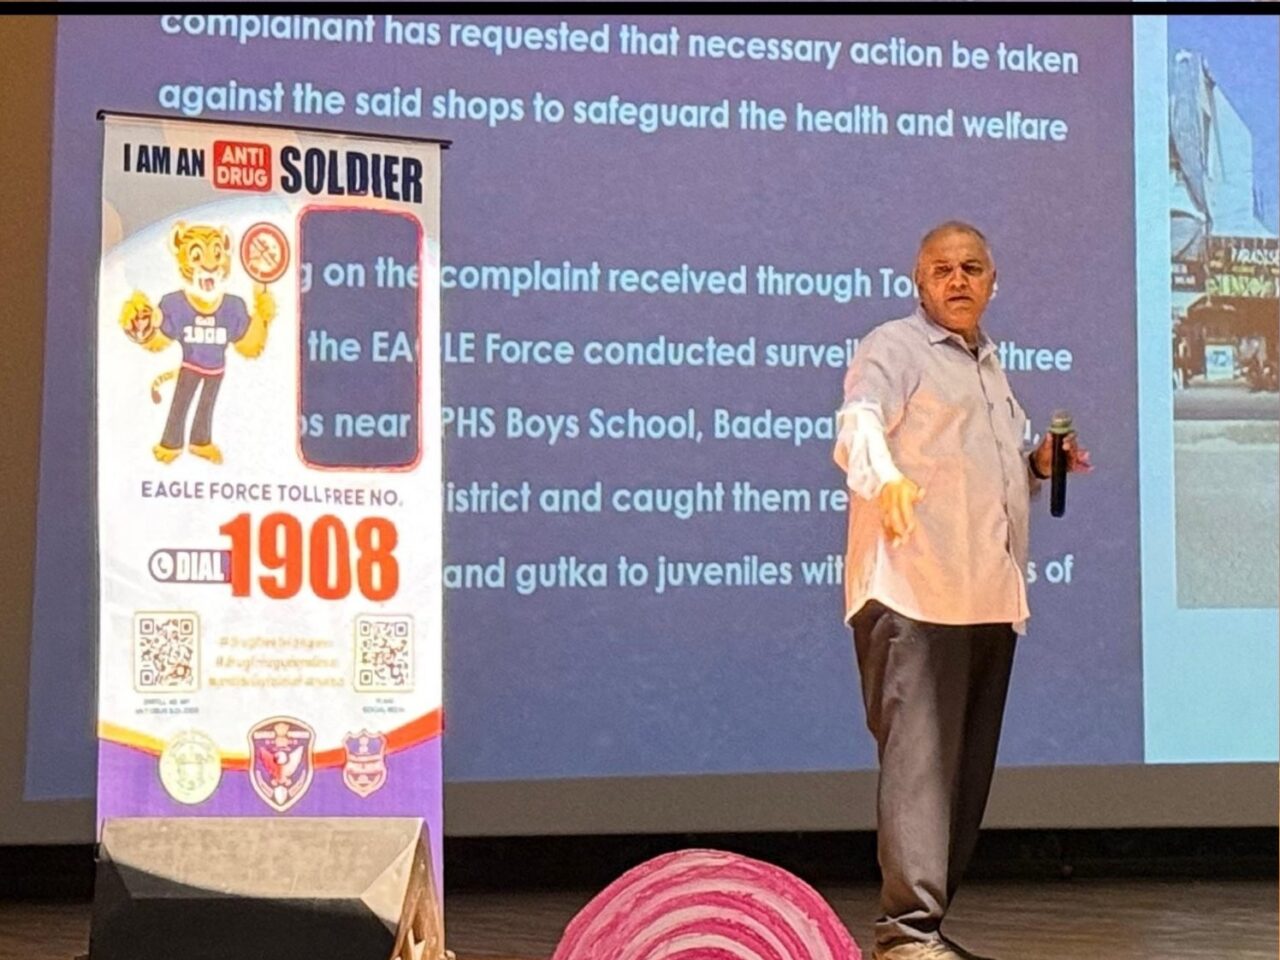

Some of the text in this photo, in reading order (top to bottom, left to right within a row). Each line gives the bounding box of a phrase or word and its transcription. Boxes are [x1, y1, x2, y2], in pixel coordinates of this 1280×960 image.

[161, 15, 1078, 73] complainant has requested that necessary action be taken
[159, 80, 1067, 140] against the said shops to safeguard the health and welfare
[123, 143, 205, 177] I AM AN
[221, 144, 265, 166] ANTI
[280, 145, 423, 204] SOLDIER
[216, 166, 268, 187] DRUG
[324, 264, 364, 287] on
[375, 257, 420, 288] the
[438, 260, 600, 300] complaint
[609, 264, 746, 294] received
[757, 266, 871, 303] through
[308, 328, 1072, 375] the EALE Force conducted three
[336, 414, 411, 437] near
[507, 408, 579, 445] Boys
[590, 408, 702, 442] School,
[141, 480, 205, 500] EAGLE
[209, 482, 272, 500] FORCE
[540, 482, 601, 512] and
[613, 482, 724, 519] caught
[732, 482, 810, 512] them
[175, 511, 399, 602] DIAL 1908
[441, 553, 504, 593] and
[516, 557, 607, 595] gutka
[618, 556, 648, 586] to
[656, 556, 792, 593] juveniles
[1046, 555, 1073, 583] of
